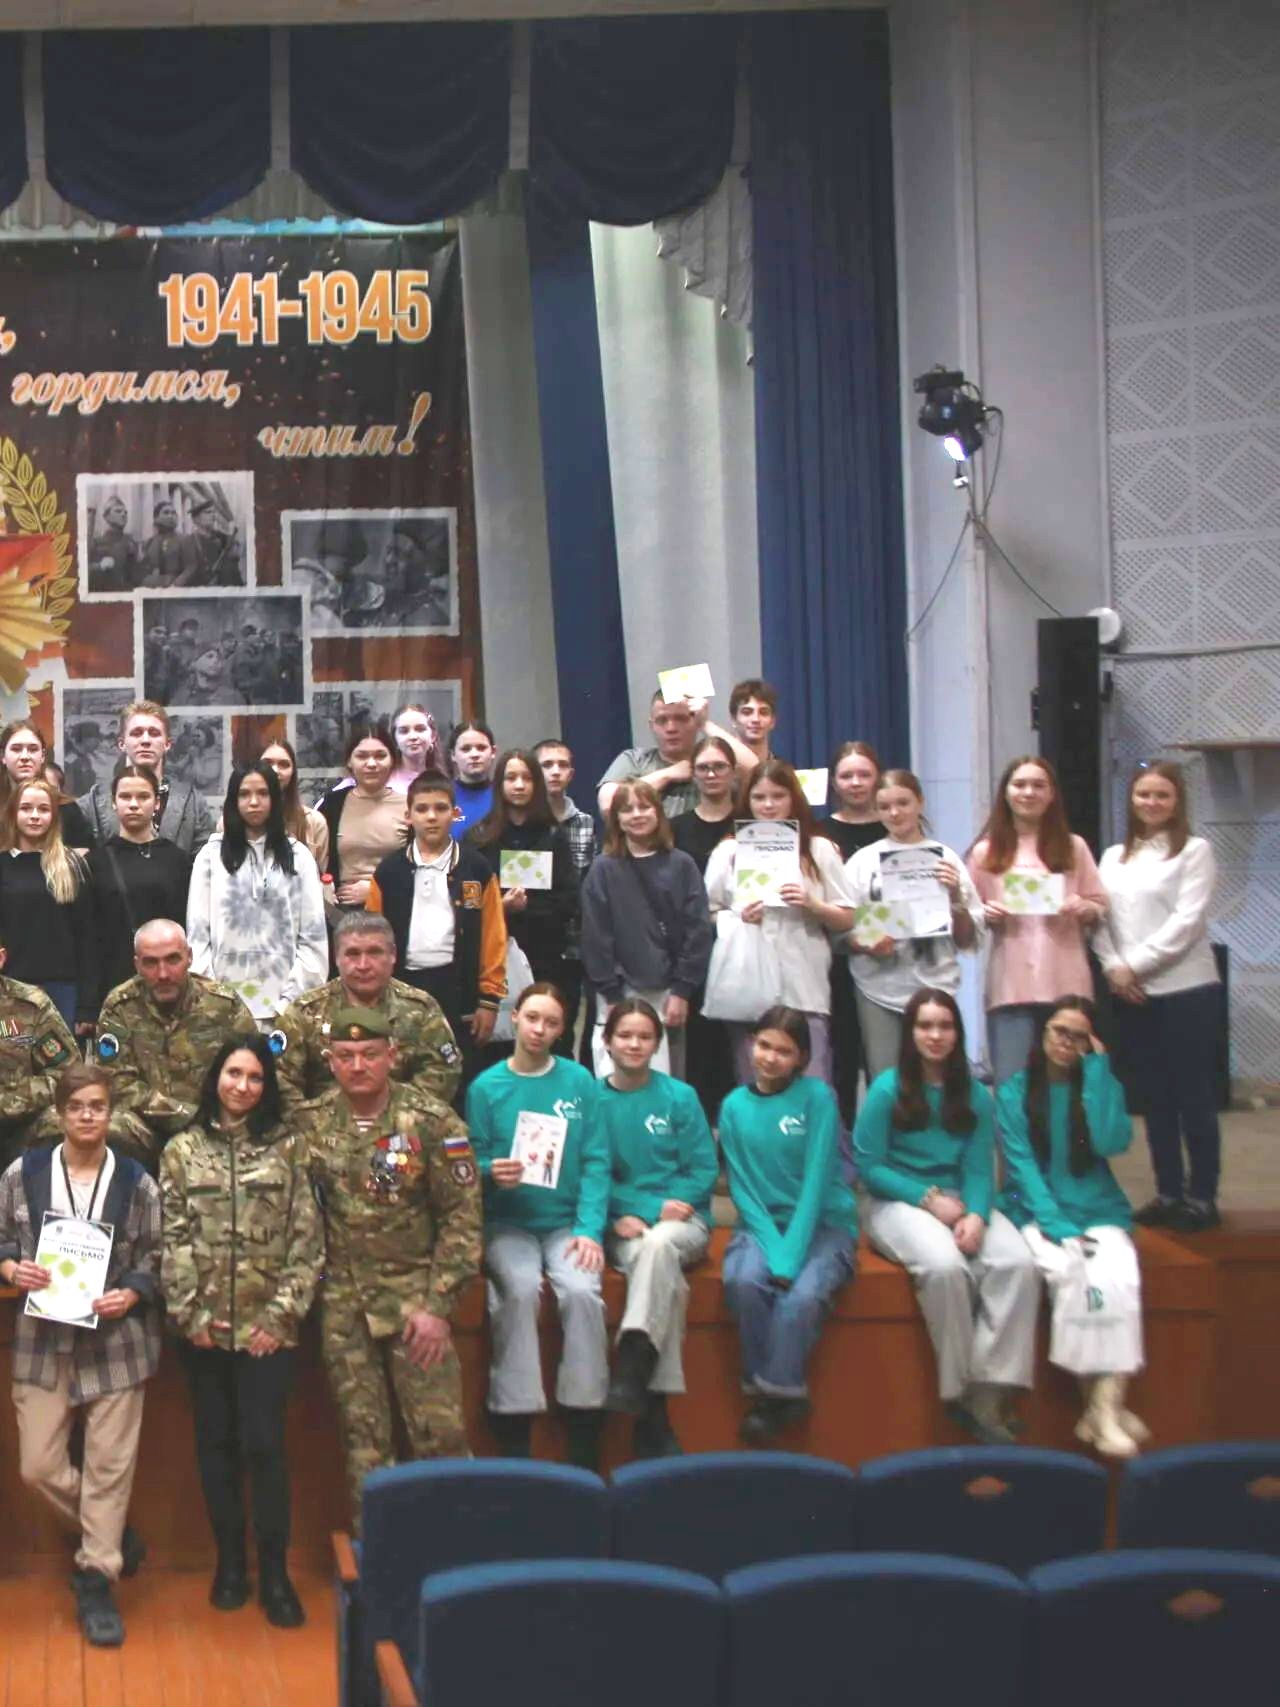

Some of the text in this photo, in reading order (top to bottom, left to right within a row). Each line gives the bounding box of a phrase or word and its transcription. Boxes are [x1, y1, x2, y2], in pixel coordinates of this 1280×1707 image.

[158, 270, 432, 347] 1941-1945
[11, 368, 241, 417] гордимся,
[256, 392, 432, 457] чтим!
